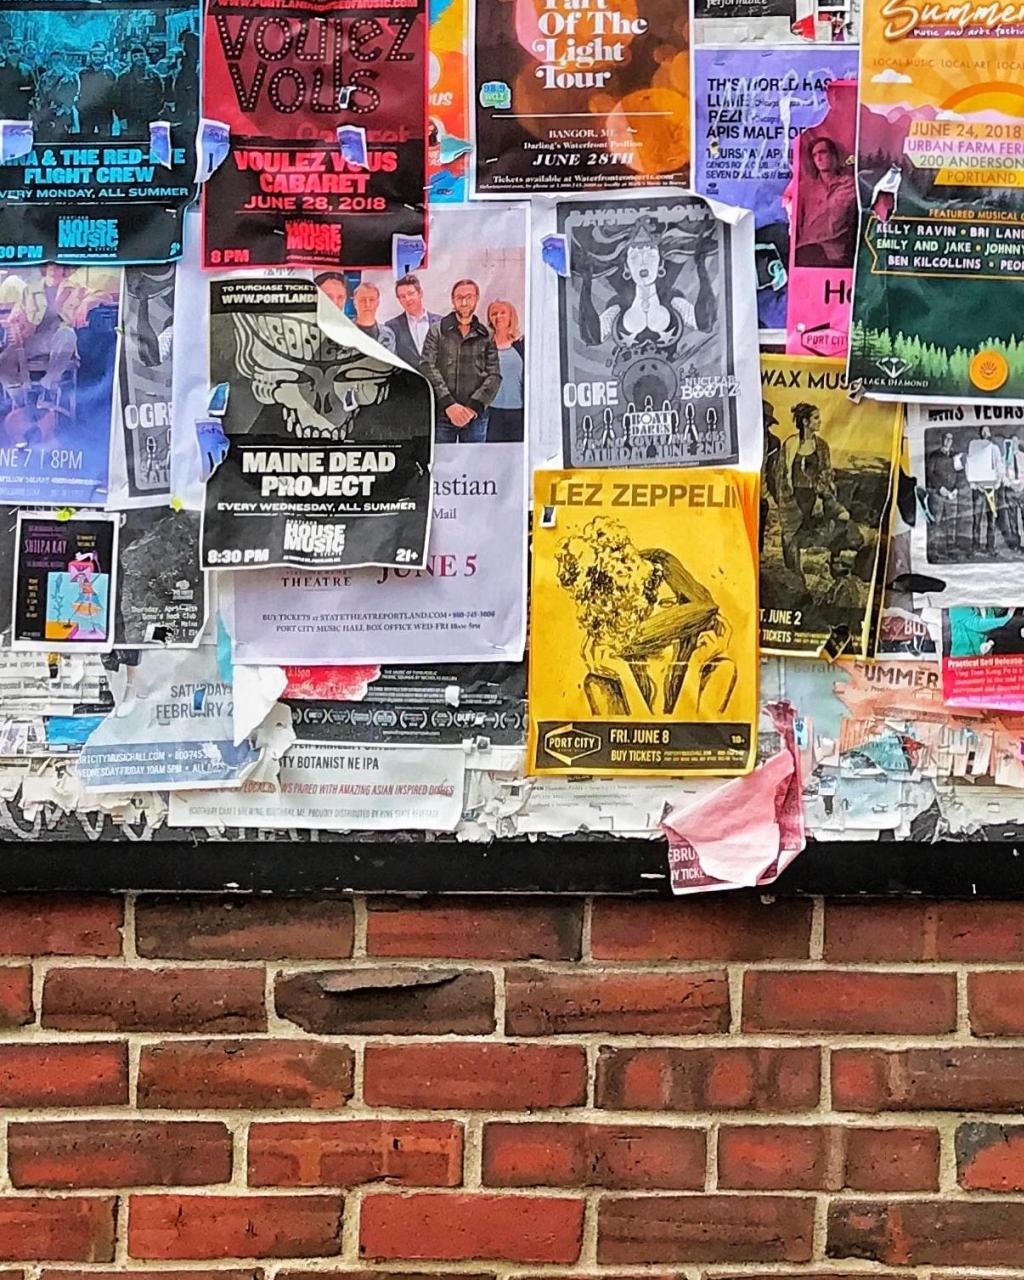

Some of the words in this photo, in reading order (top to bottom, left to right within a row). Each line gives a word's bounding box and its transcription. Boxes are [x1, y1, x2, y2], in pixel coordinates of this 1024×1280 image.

[538, 12, 579, 35] Of
[588, 12, 649, 35] The
[532, 38, 625, 68] Light
[535, 65, 612, 89] Tour
[908, 140, 954, 154] URBAN
[958, 141, 995, 154] FARM
[235, 151, 323, 172] VOULEZ
[532, 154, 581, 167] JUNE
[920, 155, 944, 167] 200
[949, 156, 1024, 169] ANDERSON
[25, 168, 92, 185] FLIGHT
[95, 166, 154, 183] CREW
[259, 174, 370, 194] CABARET
[888, 255, 909, 266] BEN
[913, 256, 981, 269] KILCOLLINS
[563, 381, 618, 407] OGRE
[242, 452, 325, 473] MAINE
[328, 451, 397, 473] DEAD
[261, 475, 376, 497] PROJECT
[550, 483, 603, 505] LEZ
[217, 502, 257, 511] EVERY
[259, 502, 333, 513] WEDNESDAY,
[336, 502, 360, 511] ALL
[363, 501, 416, 511] SUMMER
[208, 549, 241, 564] 8:30
[243, 548, 269, 563] PM
[396, 549, 419, 562] 21+
[281, 577, 351, 587] THEATRE
[549, 737, 572, 749] PORT
[574, 736, 596, 749] CITY
[297, 756, 345, 769] BOTANIST
[348, 758, 360, 769] NE
[363, 758, 379, 770] IPA
[611, 750, 629, 762] BUY
[632, 750, 662, 762] TICKETS
